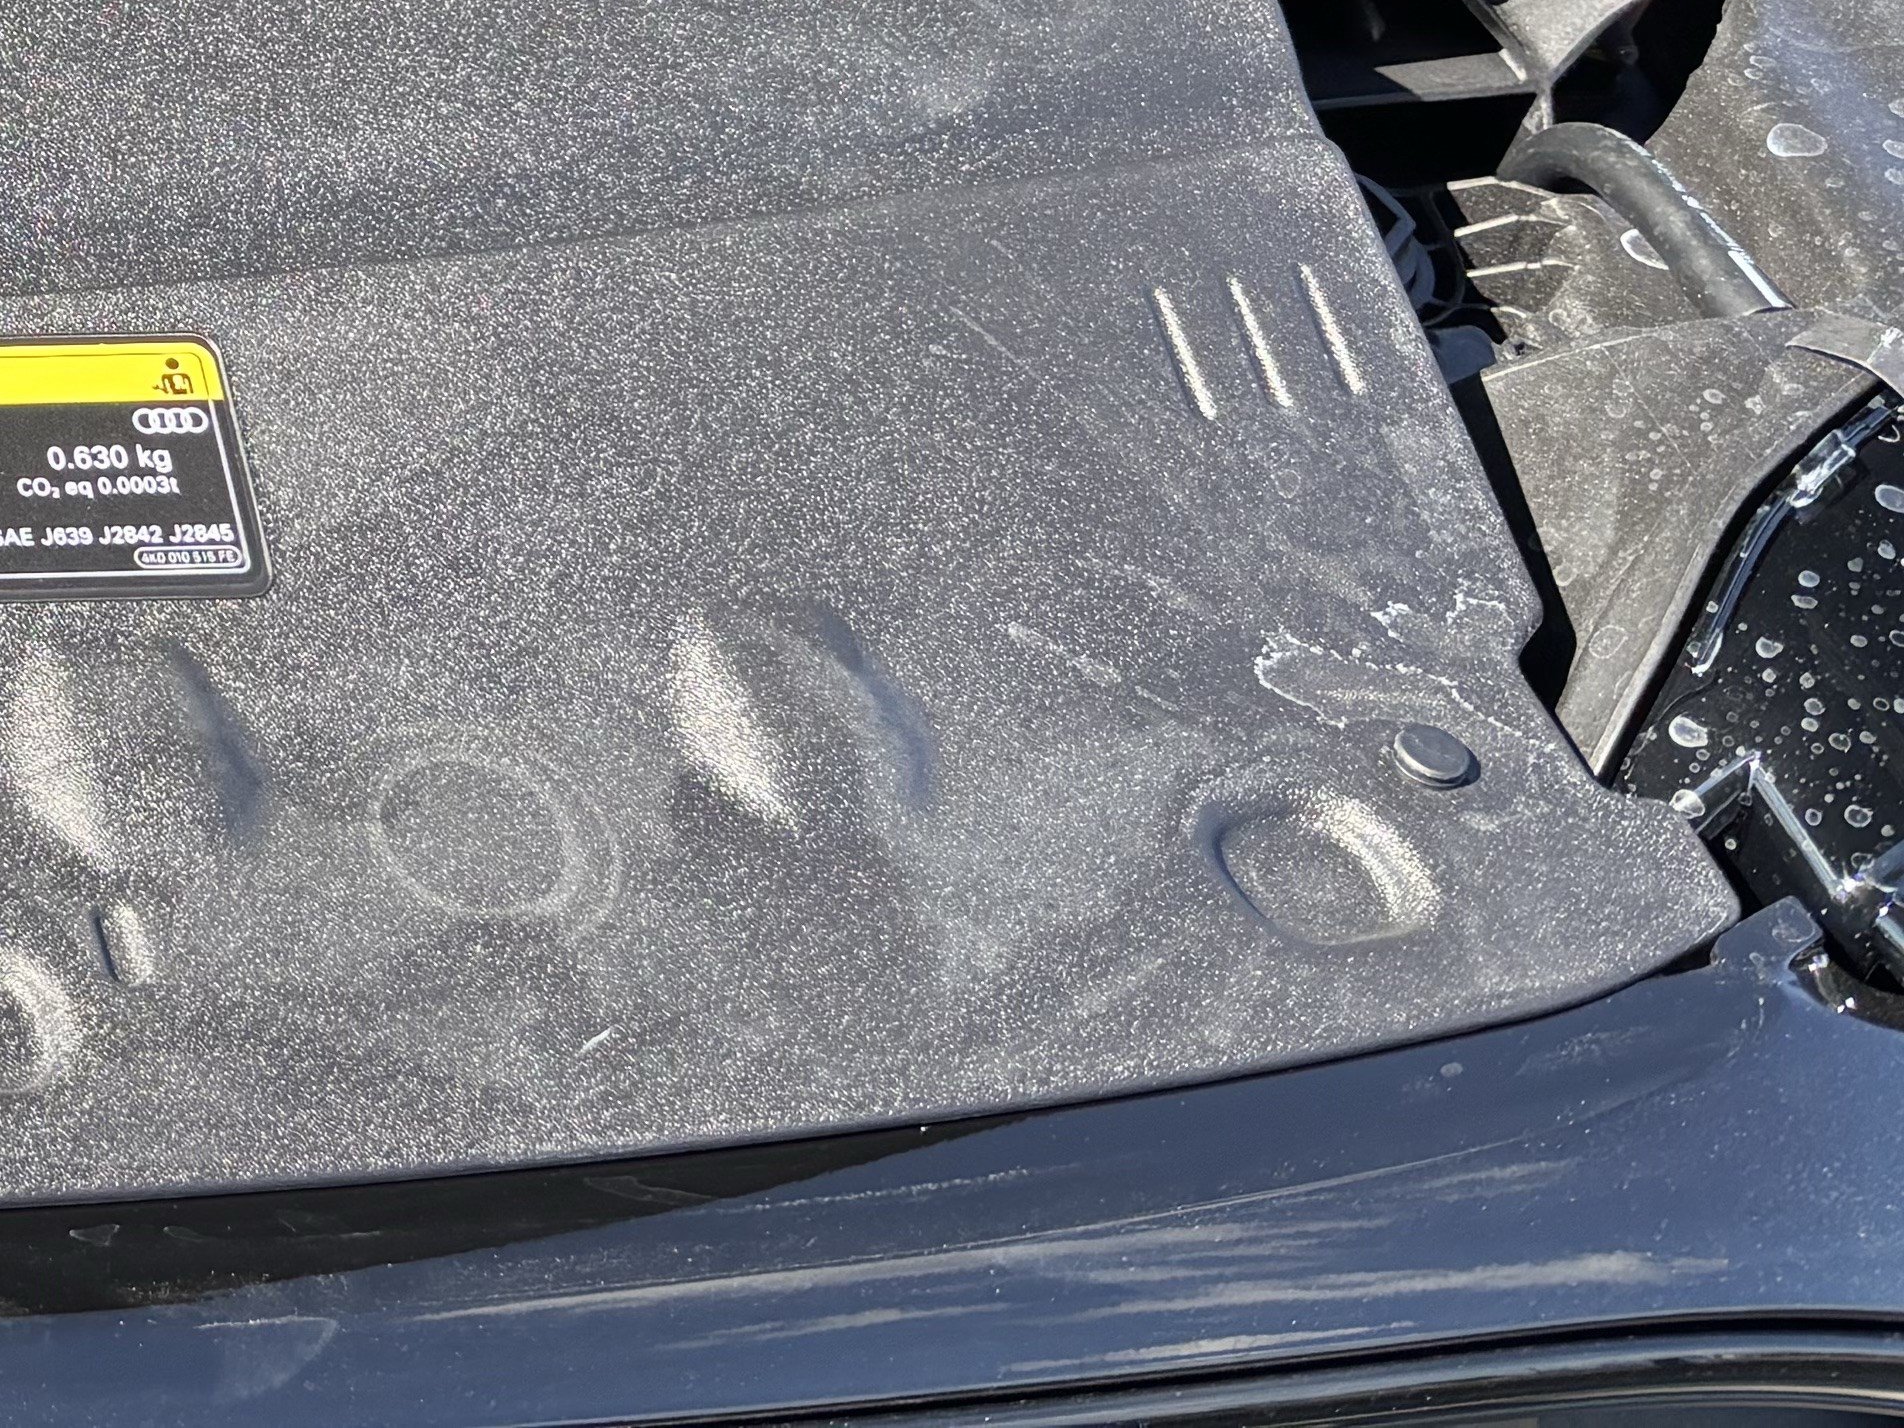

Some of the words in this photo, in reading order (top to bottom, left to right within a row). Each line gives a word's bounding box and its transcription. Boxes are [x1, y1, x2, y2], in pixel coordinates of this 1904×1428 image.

[47, 444, 128, 471] 0.630
[135, 444, 173, 476] kg
[64, 479, 94, 500] eq
[39, 525, 93, 546] J639
[98, 523, 164, 546] J2842
[168, 521, 235, 544] J2845
